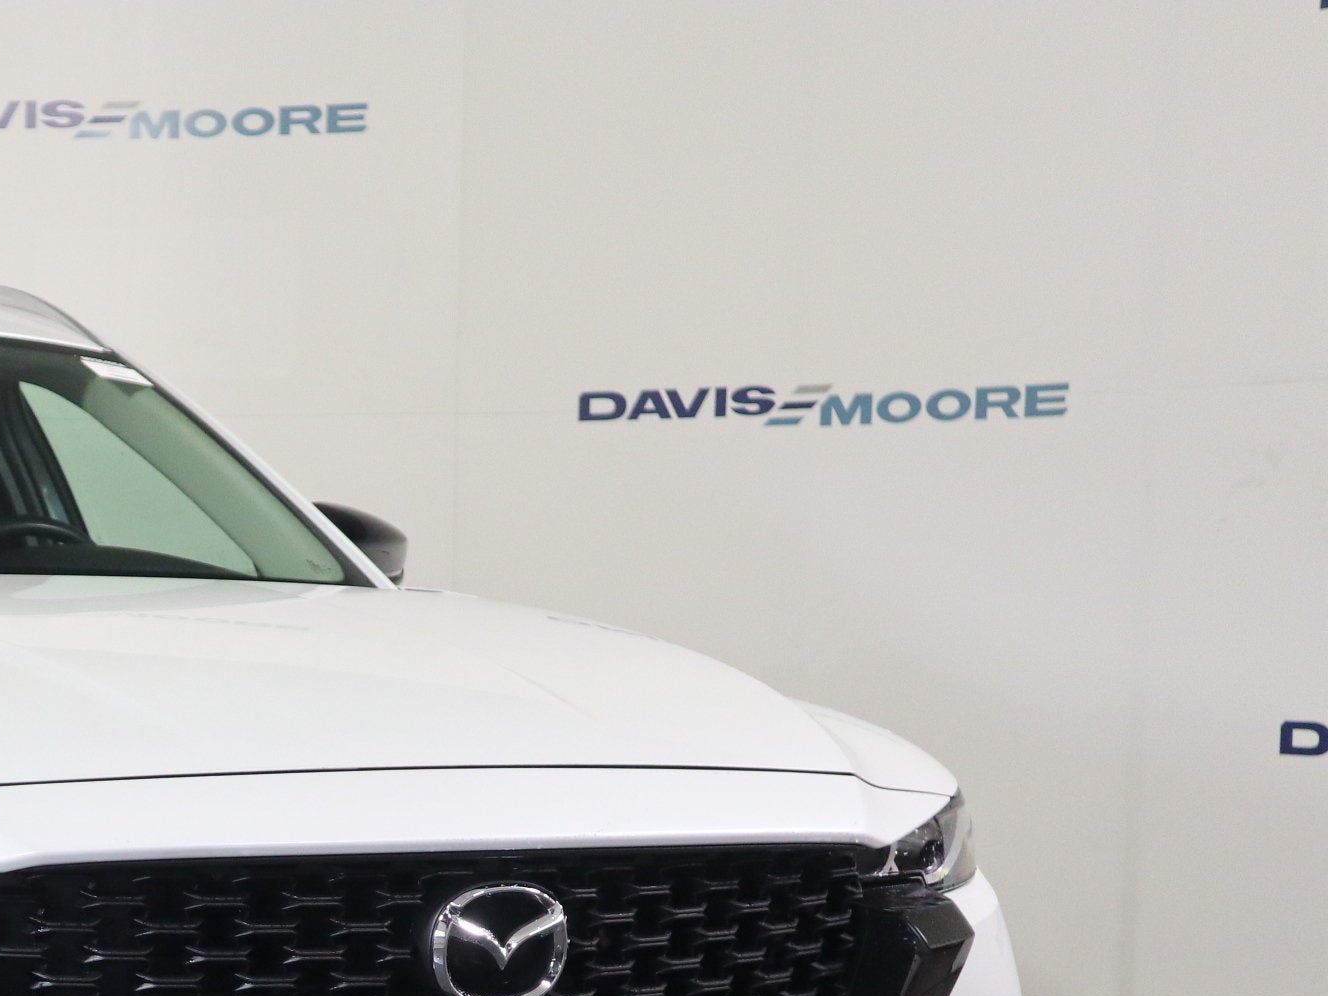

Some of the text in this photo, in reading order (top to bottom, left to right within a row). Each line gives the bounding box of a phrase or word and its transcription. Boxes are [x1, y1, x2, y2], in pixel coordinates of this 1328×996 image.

[129, 102, 369, 140] MOORE
[577, 382, 1070, 428] DAVIS MOORE
